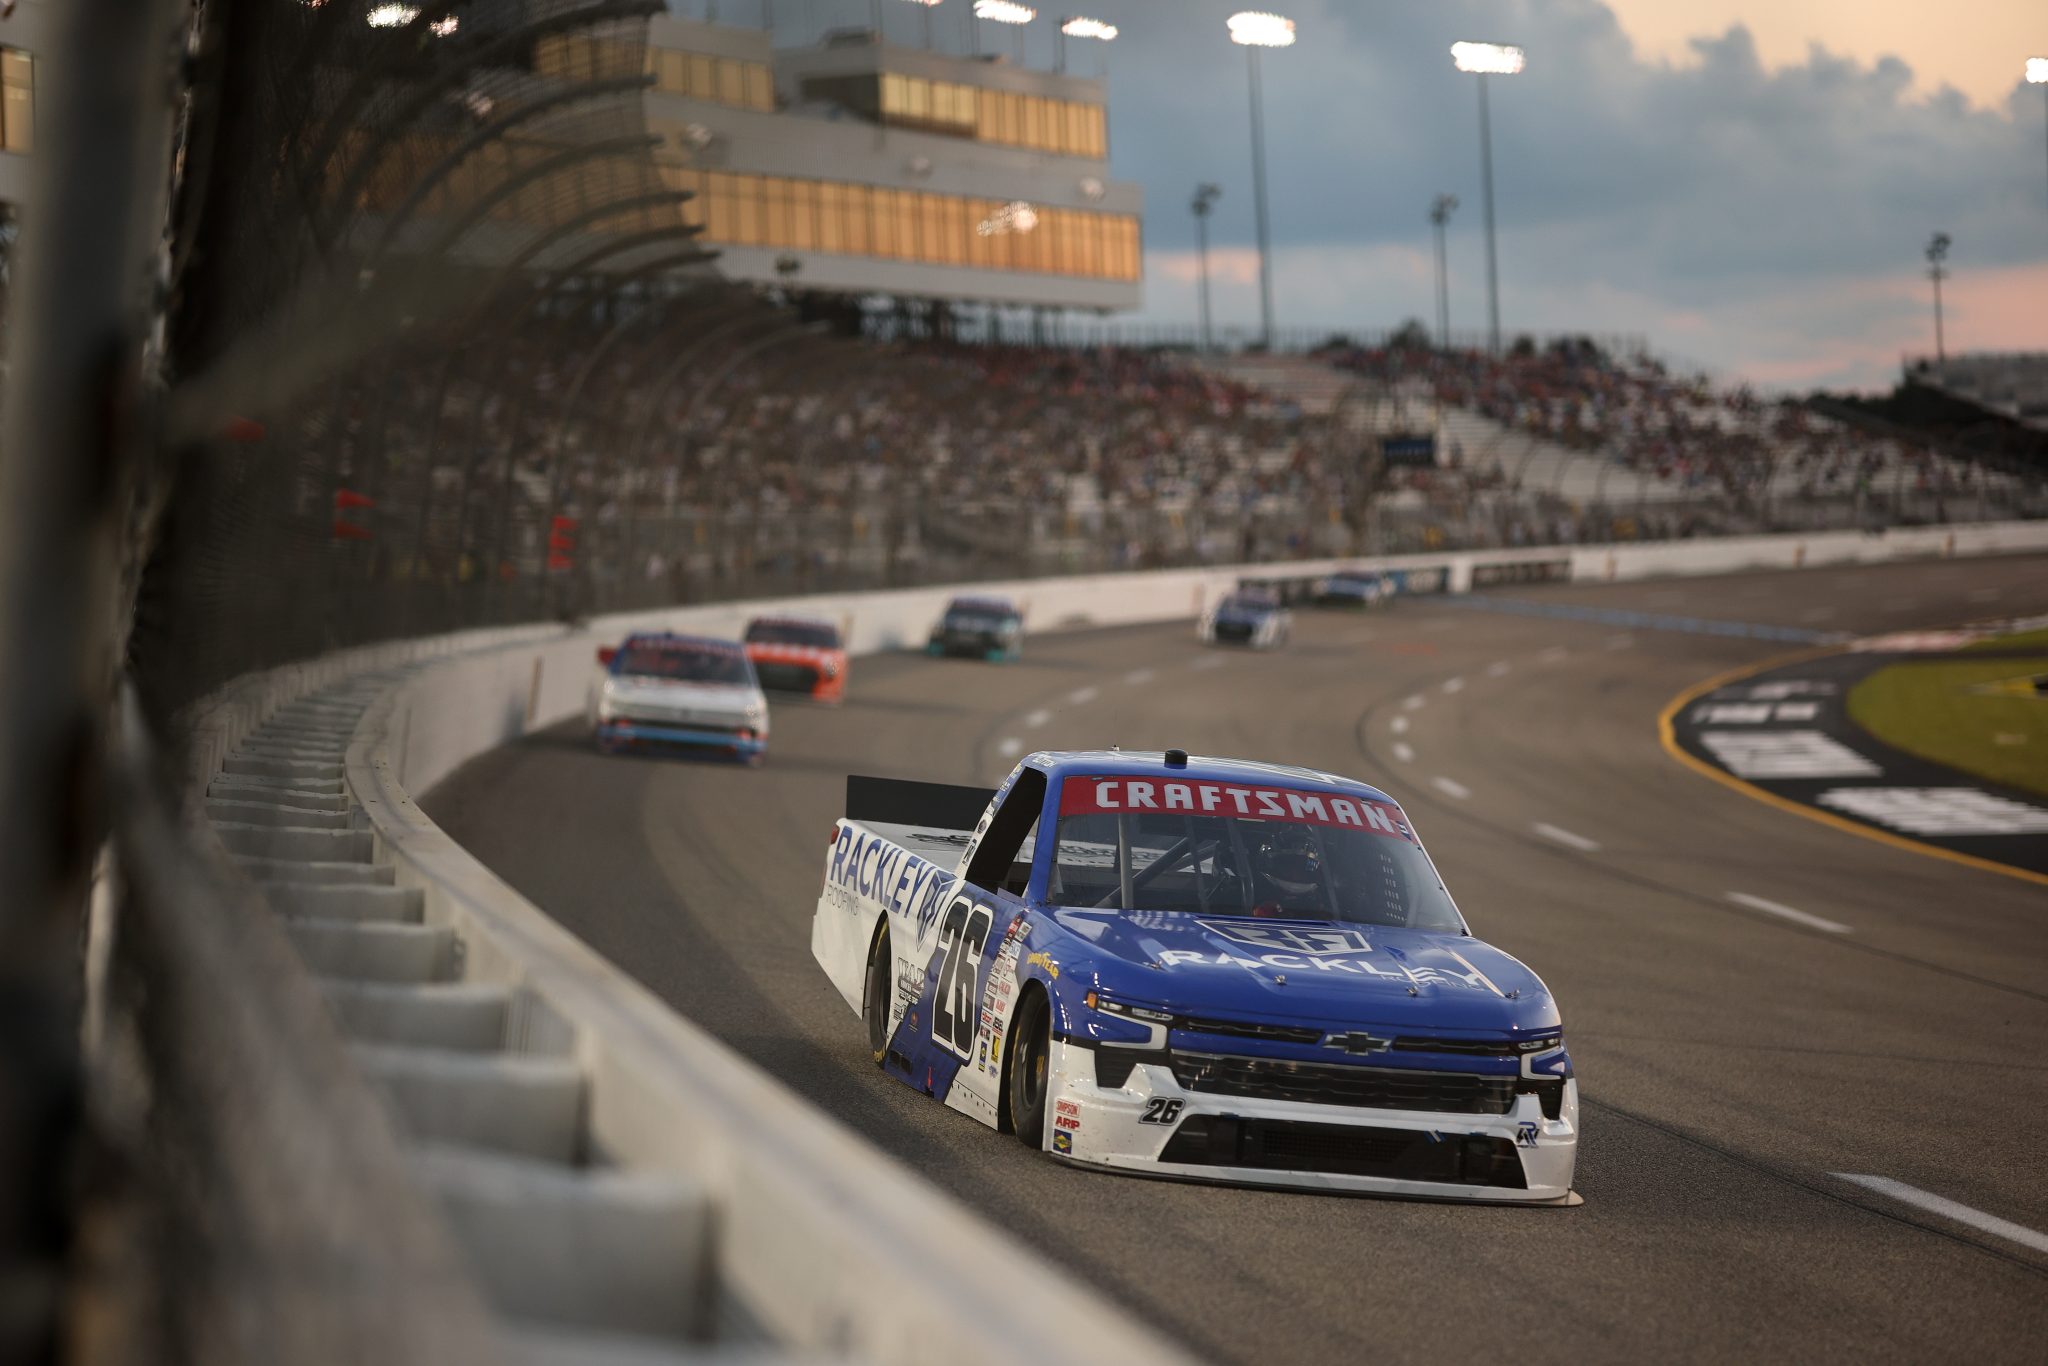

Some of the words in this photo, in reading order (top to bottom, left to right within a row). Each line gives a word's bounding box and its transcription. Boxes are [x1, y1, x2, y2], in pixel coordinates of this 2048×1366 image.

[1096, 781, 1395, 834] CRAFTSMAN
[830, 825, 937, 918] RACKLEY
[826, 884, 859, 916] ROOFING
[932, 895, 994, 1061] 26
[1158, 950, 1481, 986] RACKLEY
[1055, 1116, 1080, 1129] ARP
[1139, 1096, 1185, 1126] 26
